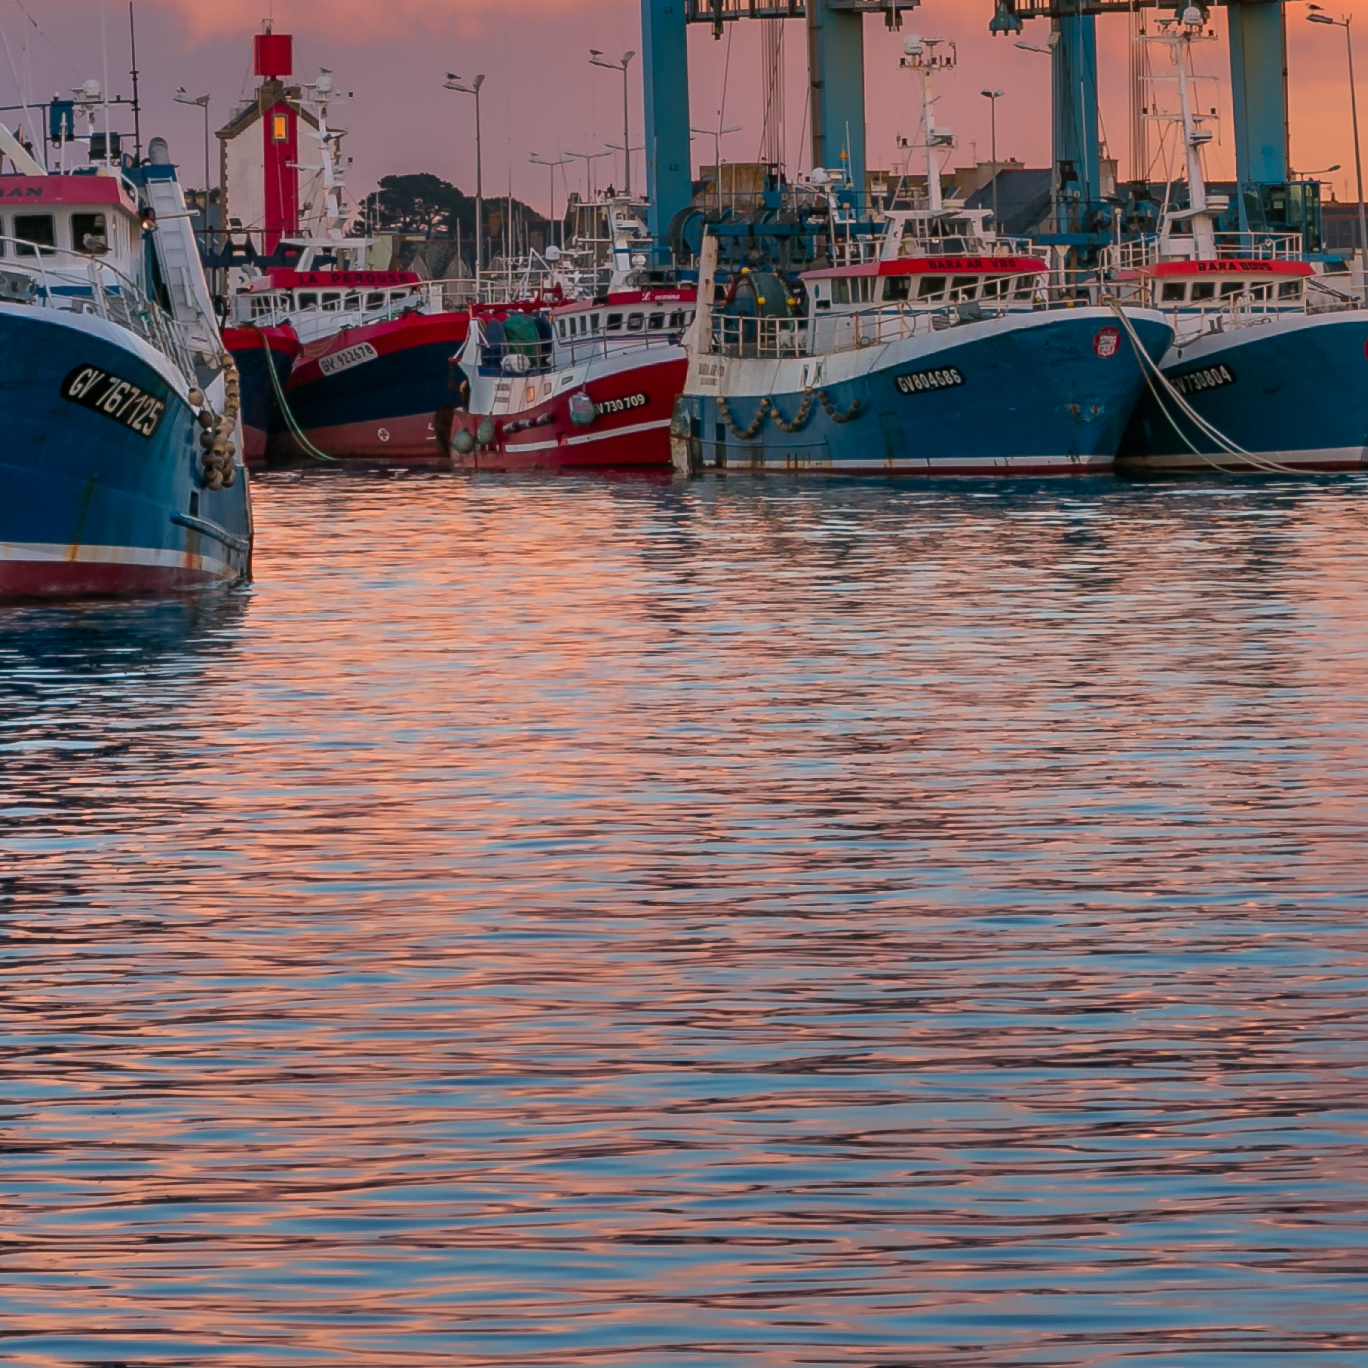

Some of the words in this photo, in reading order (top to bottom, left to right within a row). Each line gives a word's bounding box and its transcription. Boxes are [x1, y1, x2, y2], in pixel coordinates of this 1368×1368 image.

[928, 260, 963, 269] BARA
[967, 260, 982, 269] AR
[1198, 262, 1237, 271] BARA
[298, 275, 318, 284] LA
[332, 273, 408, 284] PEROUSE
[321, 358, 336, 372] GV
[336, 344, 375, 366] 922678
[68, 368, 106, 399] GV
[95, 376, 164, 436] 767125
